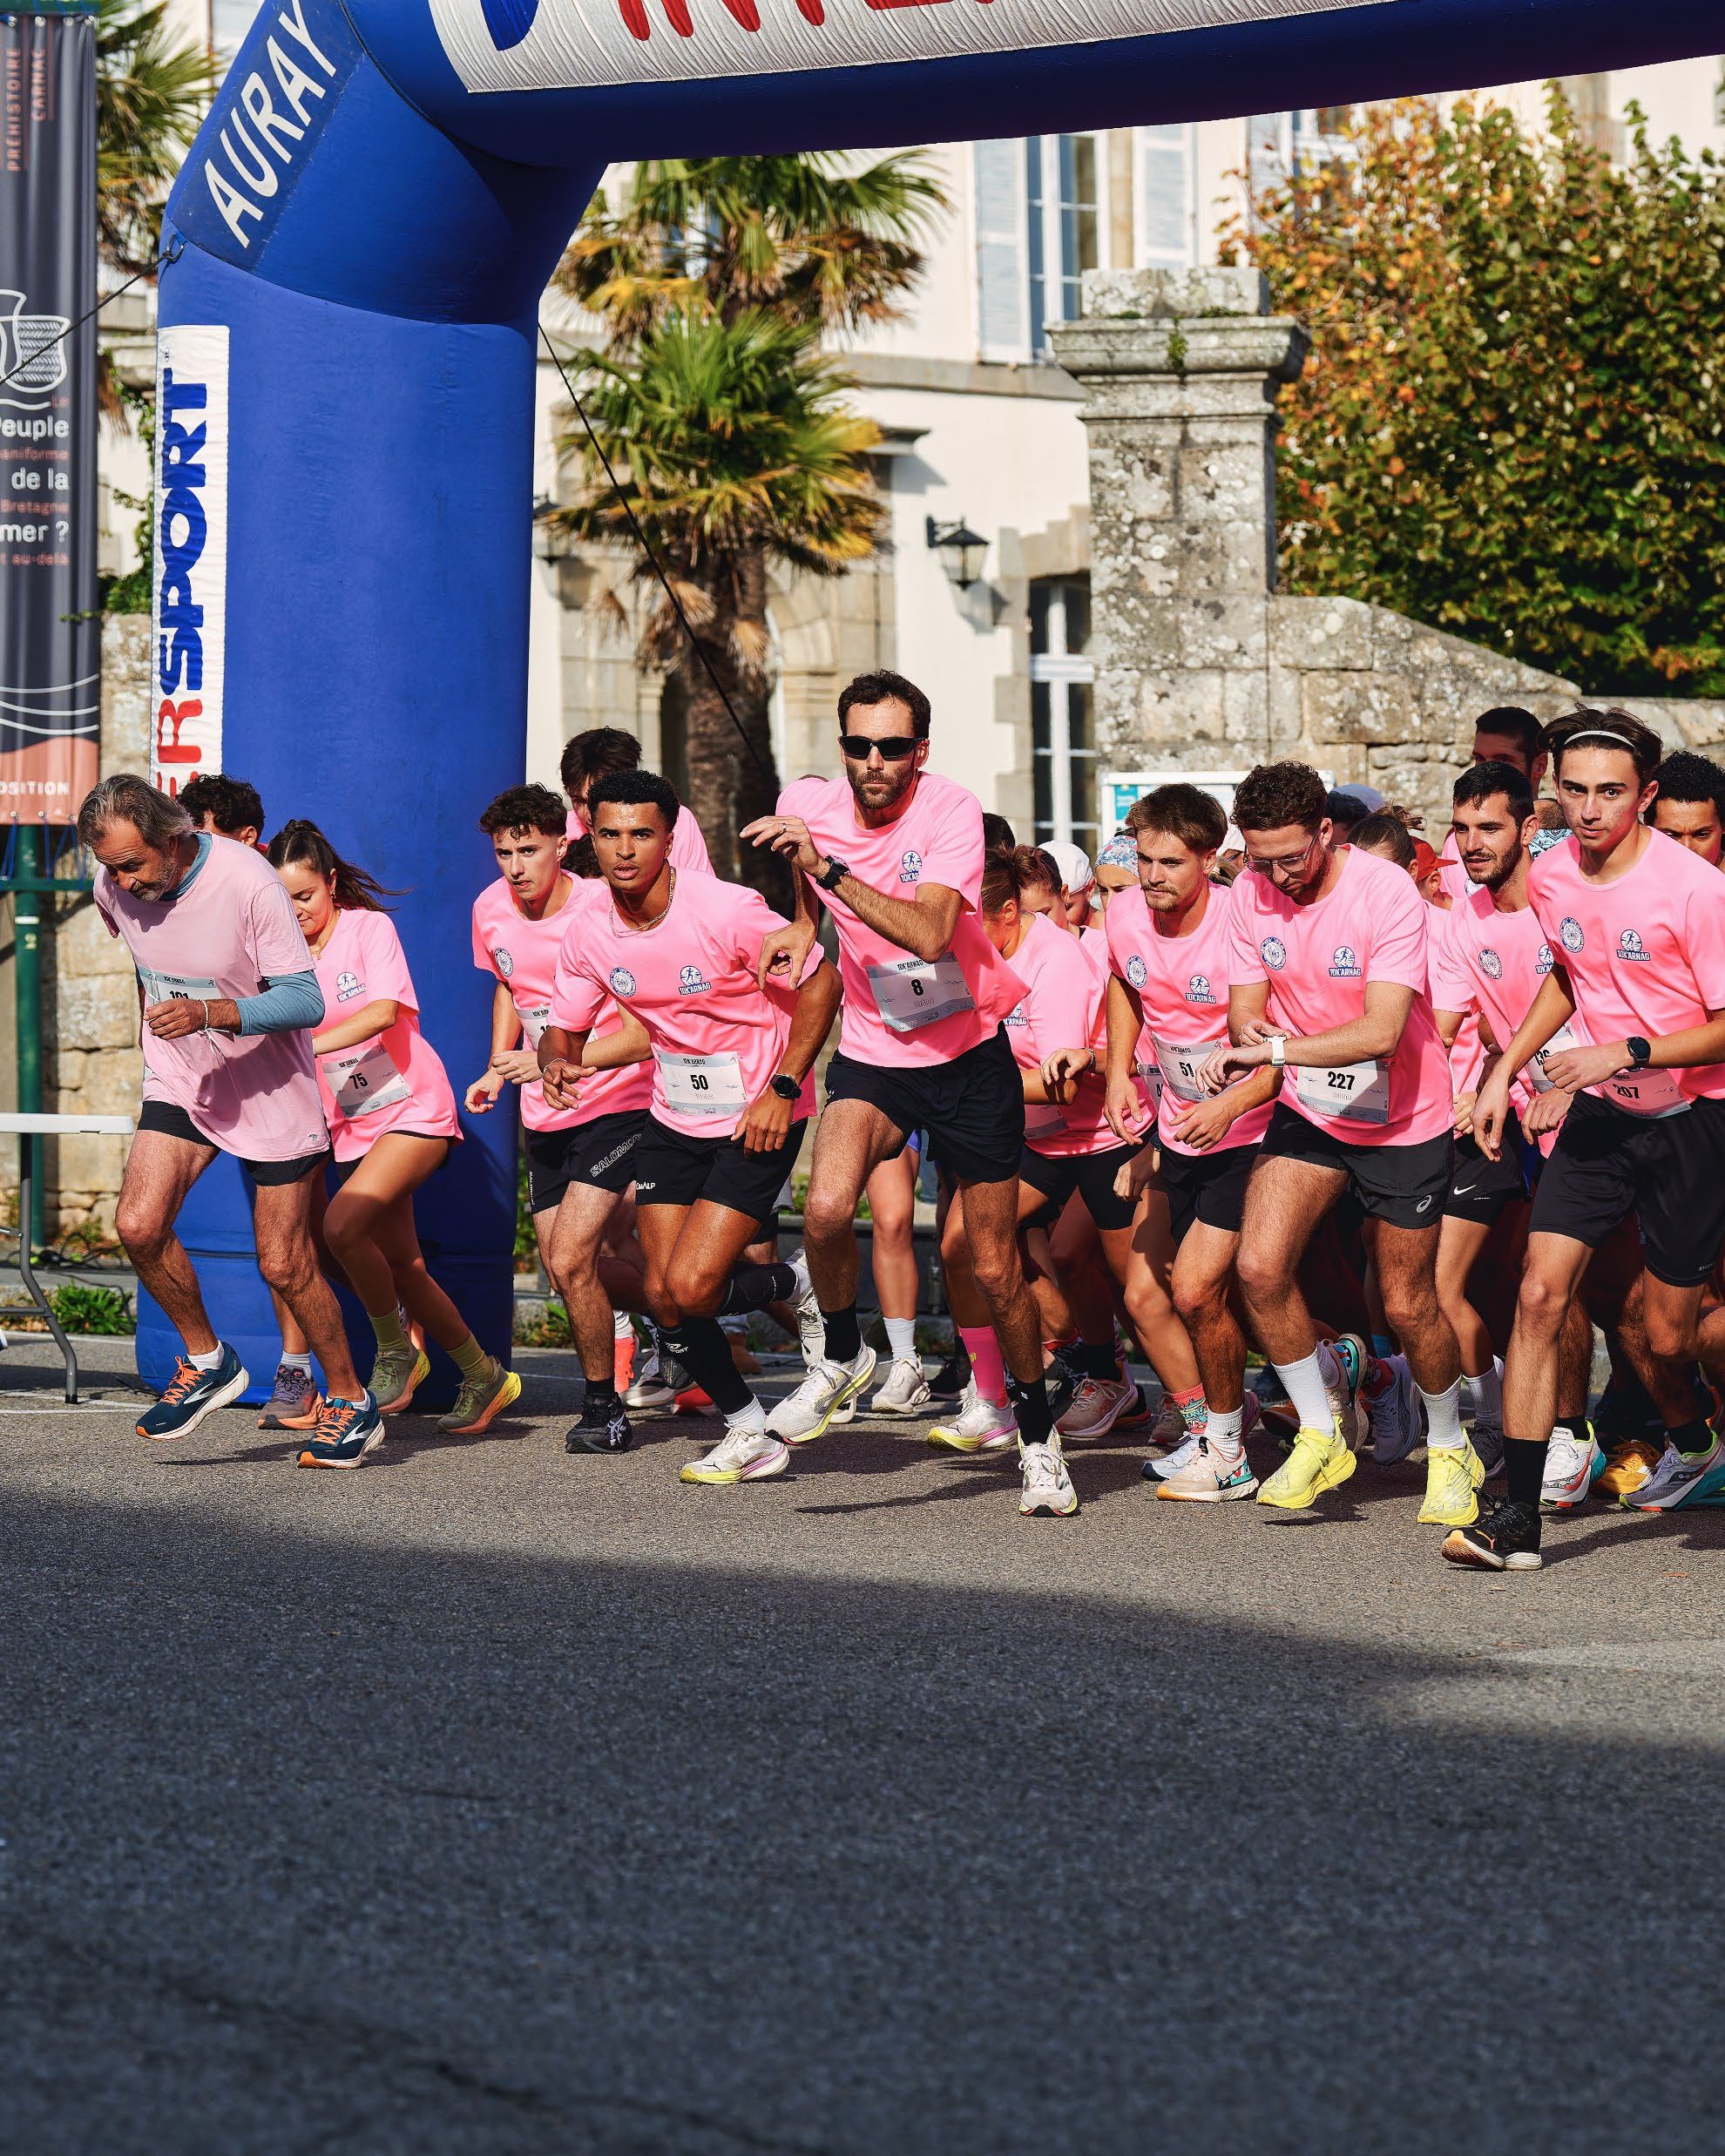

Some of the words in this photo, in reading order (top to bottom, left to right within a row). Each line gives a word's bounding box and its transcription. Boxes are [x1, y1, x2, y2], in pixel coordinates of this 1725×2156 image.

[31, 48, 46, 121] CARNAC
[205, 0, 337, 249] AURAY
[0, 415, 70, 442] euple
[11, 467, 41, 490] de
[48, 468, 70, 490] la
[0, 524, 50, 543] mer
[56, 520, 70, 543] ?
[911, 979, 924, 996] 8
[1179, 1062, 1194, 1077] 51
[349, 1072, 369, 1089] 75
[690, 1074, 709, 1090] 50
[1328, 1071, 1356, 1091] 227
[1613, 1083, 1640, 1098] 207
[590, 1134, 642, 1177] SALOMON
